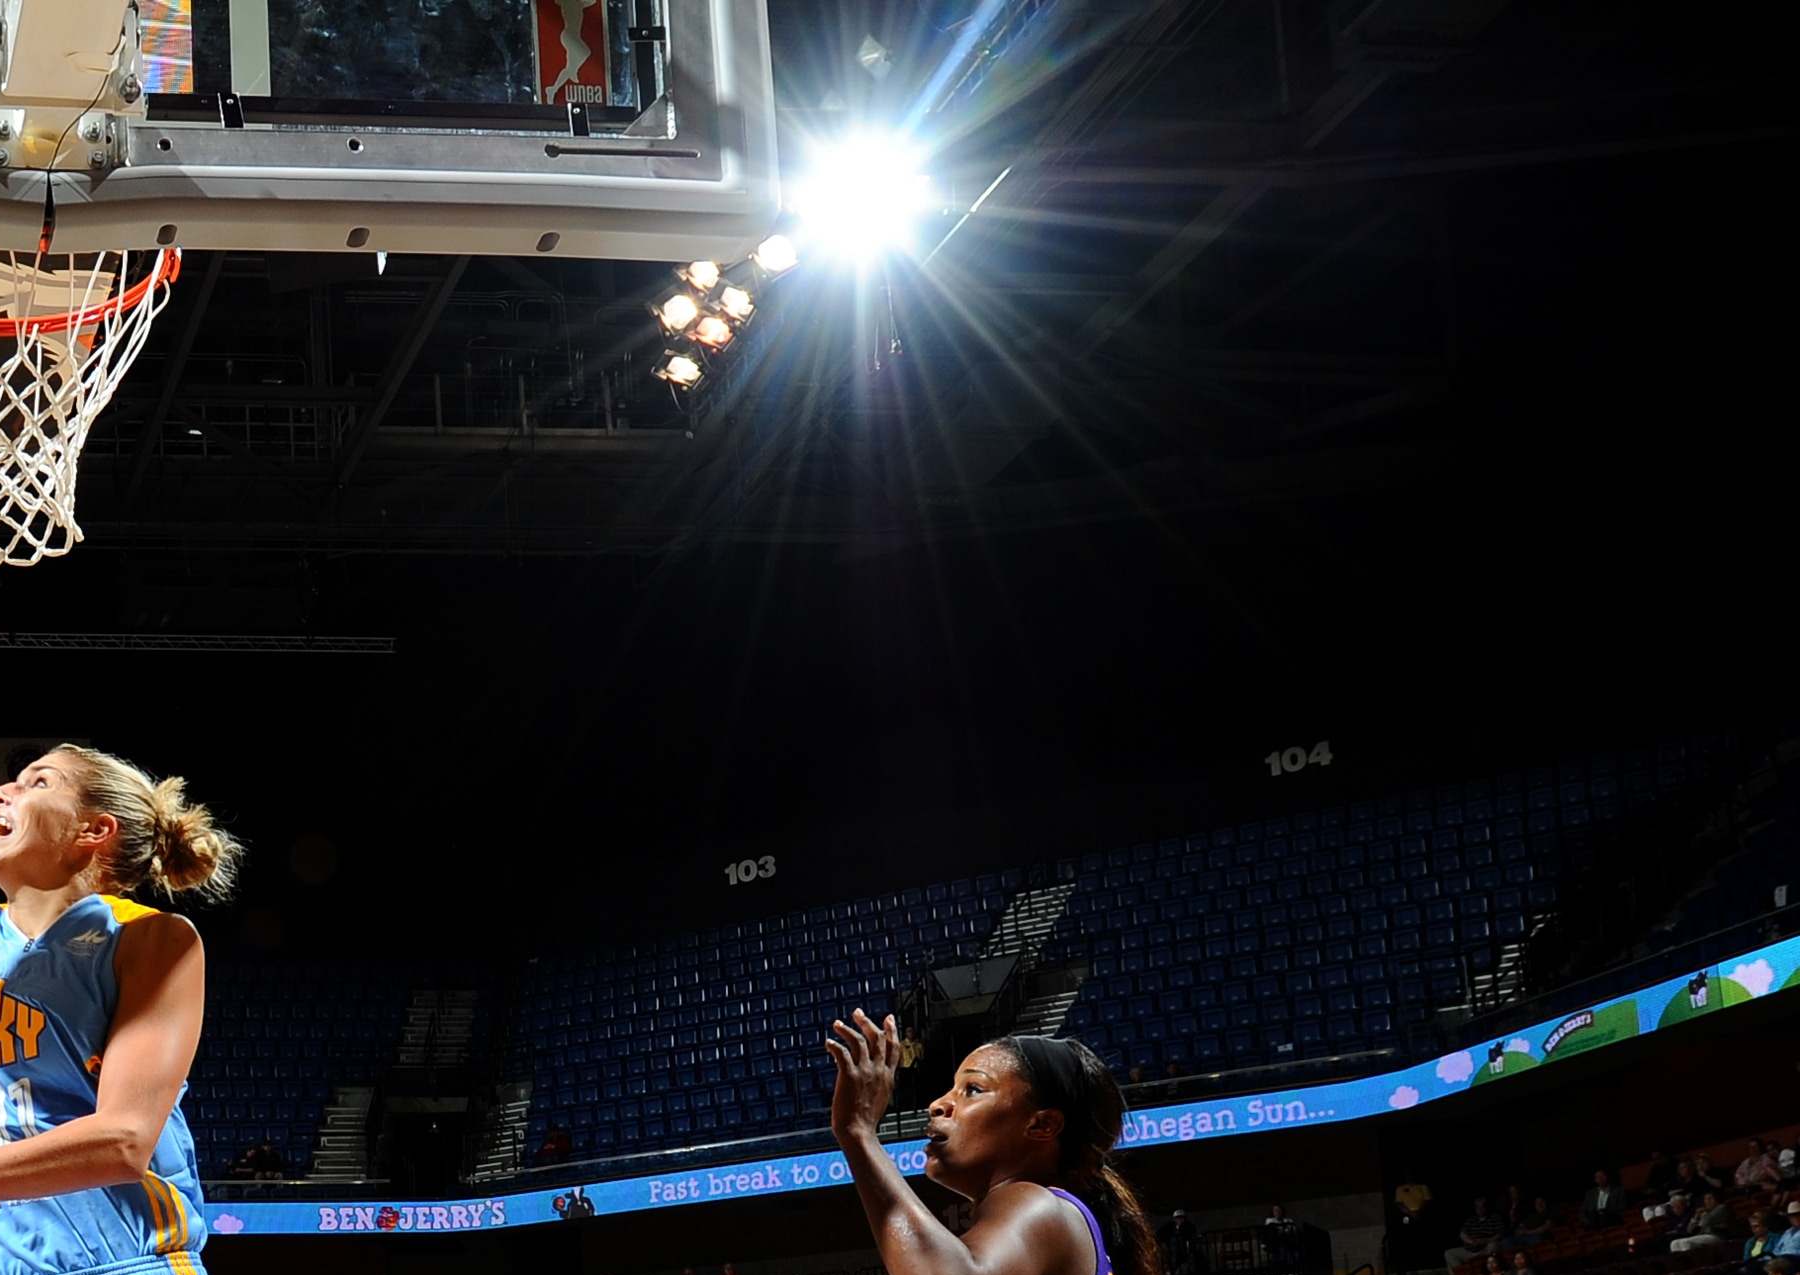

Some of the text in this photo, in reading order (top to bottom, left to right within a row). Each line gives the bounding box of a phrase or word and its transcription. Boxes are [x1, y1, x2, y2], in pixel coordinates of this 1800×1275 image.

[565, 84, 603, 104] WNBA
[1264, 739, 1334, 777] 104
[723, 854, 777, 886] 103
[1114, 1098, 1336, 1141] ohegan Sun...
[648, 1176, 701, 1204] Fast
[707, 1164, 783, 1196] break
[790, 1160, 820, 1185] to
[317, 1206, 376, 1231] BEN
[399, 1199, 508, 1230] JERRY'S
